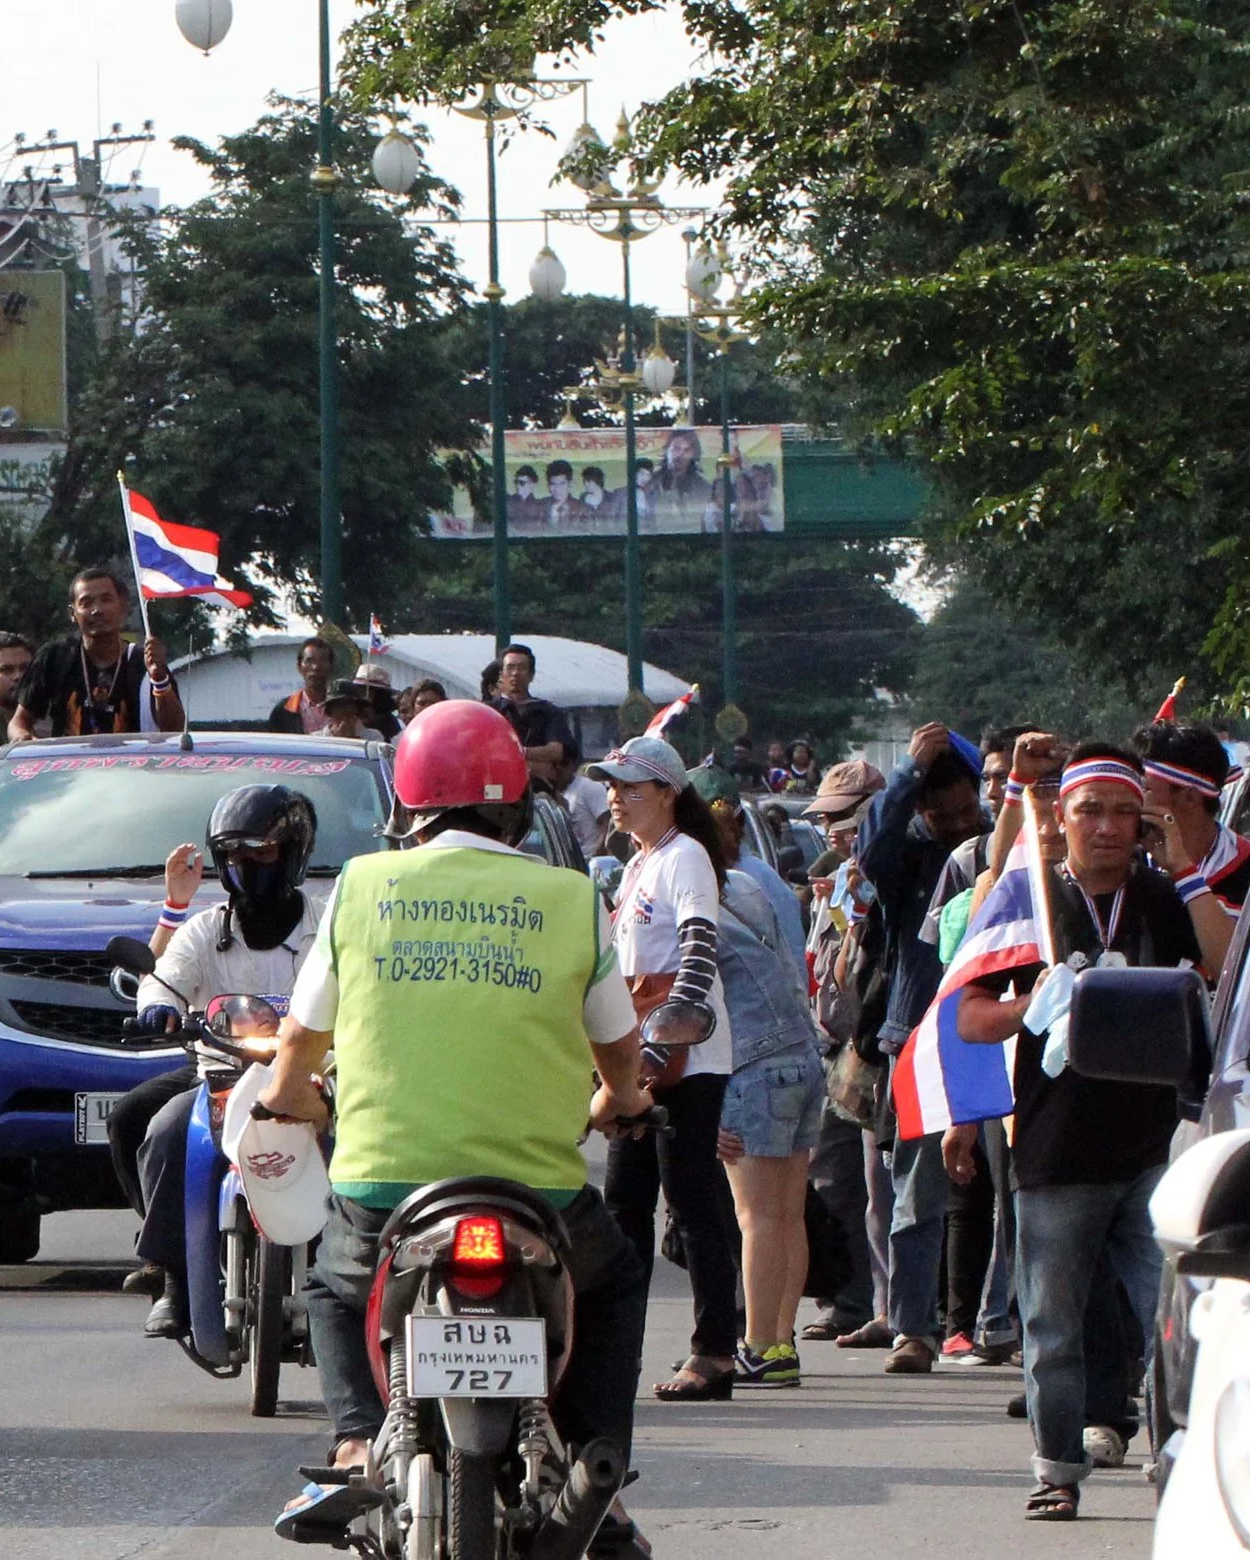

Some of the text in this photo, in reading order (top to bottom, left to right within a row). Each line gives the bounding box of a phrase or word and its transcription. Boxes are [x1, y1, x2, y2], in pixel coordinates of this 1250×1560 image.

[377, 878, 543, 932] ห้างทองเนรมิต
[392, 930, 524, 962] ตลาดสนามบินน้ำ
[375, 956, 541, 993] T.0-2921-3150#0
[418, 1352, 538, 1368] กรุงเทพมหานคร
[445, 1370, 513, 1390] 727
